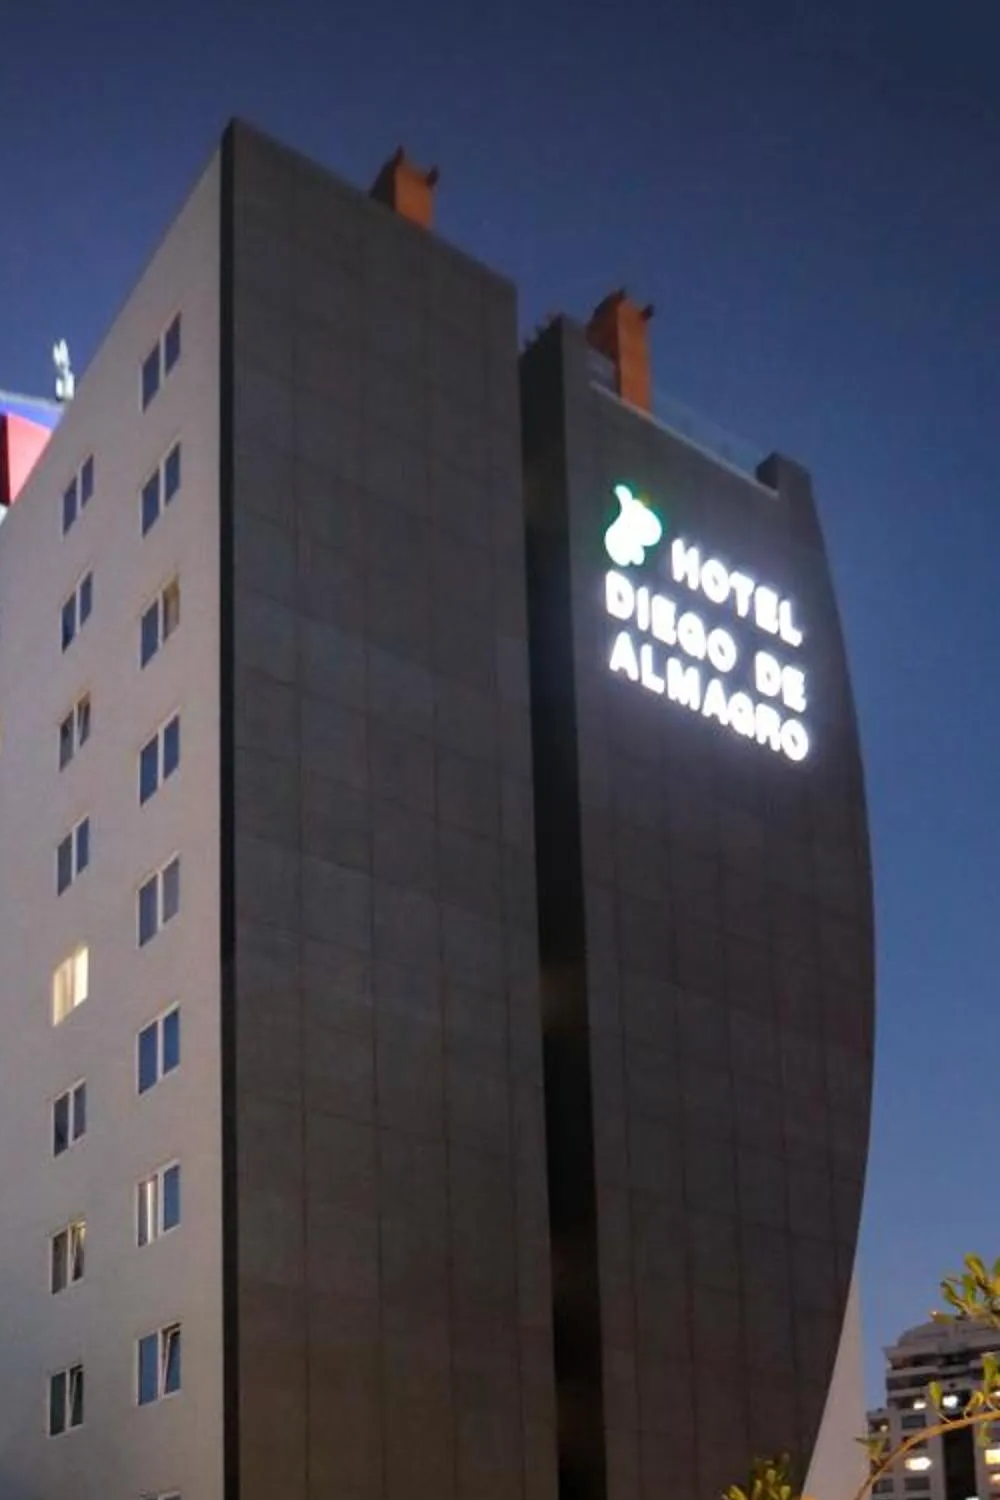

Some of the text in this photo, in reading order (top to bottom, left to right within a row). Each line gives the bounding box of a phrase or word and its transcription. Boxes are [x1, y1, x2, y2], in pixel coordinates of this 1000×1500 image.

[605, 569, 807, 713] DIEGO DE
[671, 538, 803, 647] HOTEL
[609, 631, 809, 761] ALMAGRO
